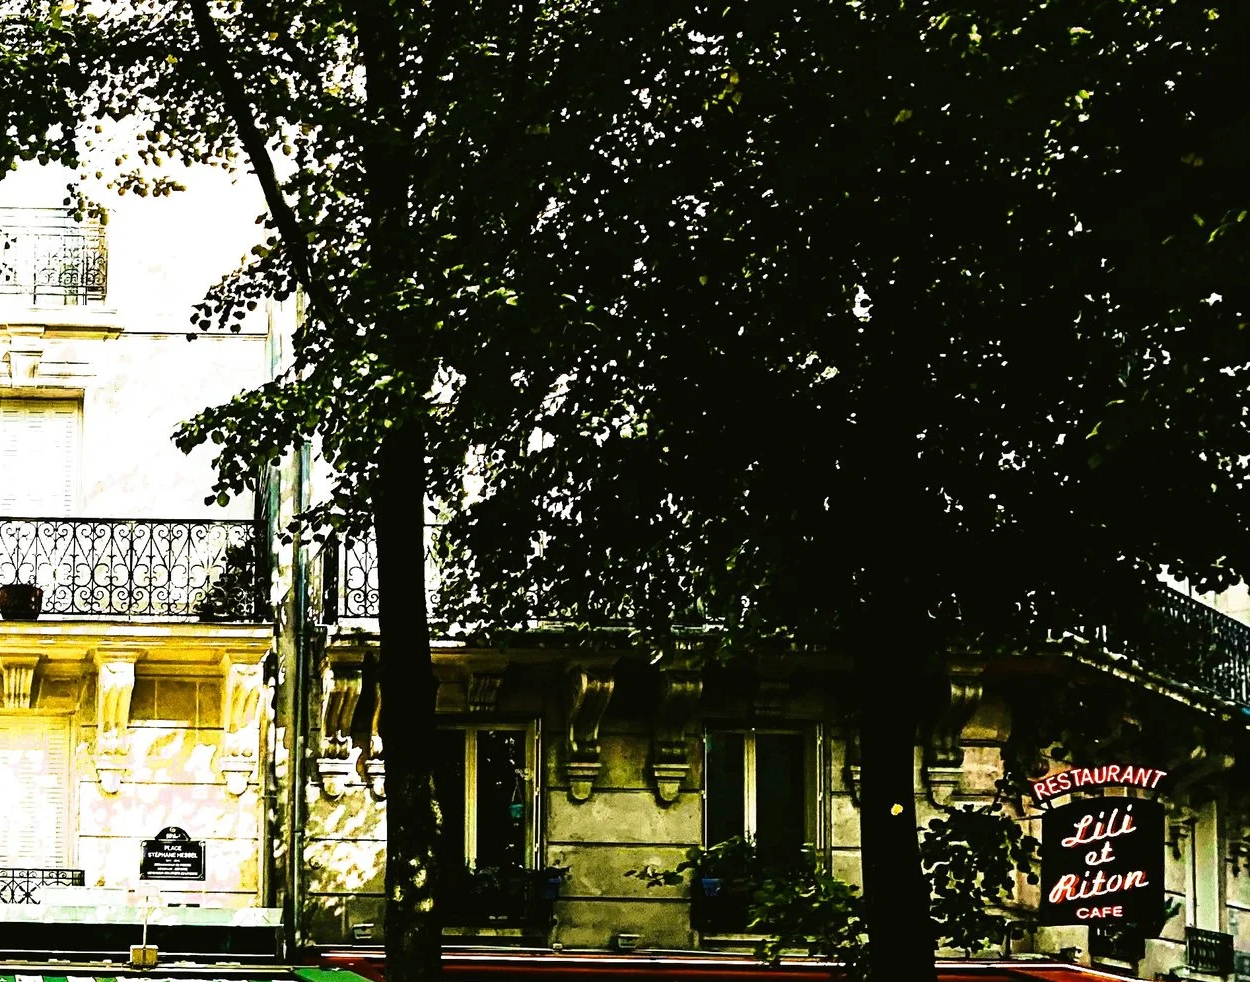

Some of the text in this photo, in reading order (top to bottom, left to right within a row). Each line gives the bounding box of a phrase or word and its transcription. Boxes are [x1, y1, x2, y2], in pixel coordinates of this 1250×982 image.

[1033, 764, 1167, 800] RESTAURANT
[1061, 804, 1137, 848] Lili
[1085, 841, 1116, 866] et
[1049, 870, 1150, 904] Riton
[1075, 905, 1123, 919] CAFE
